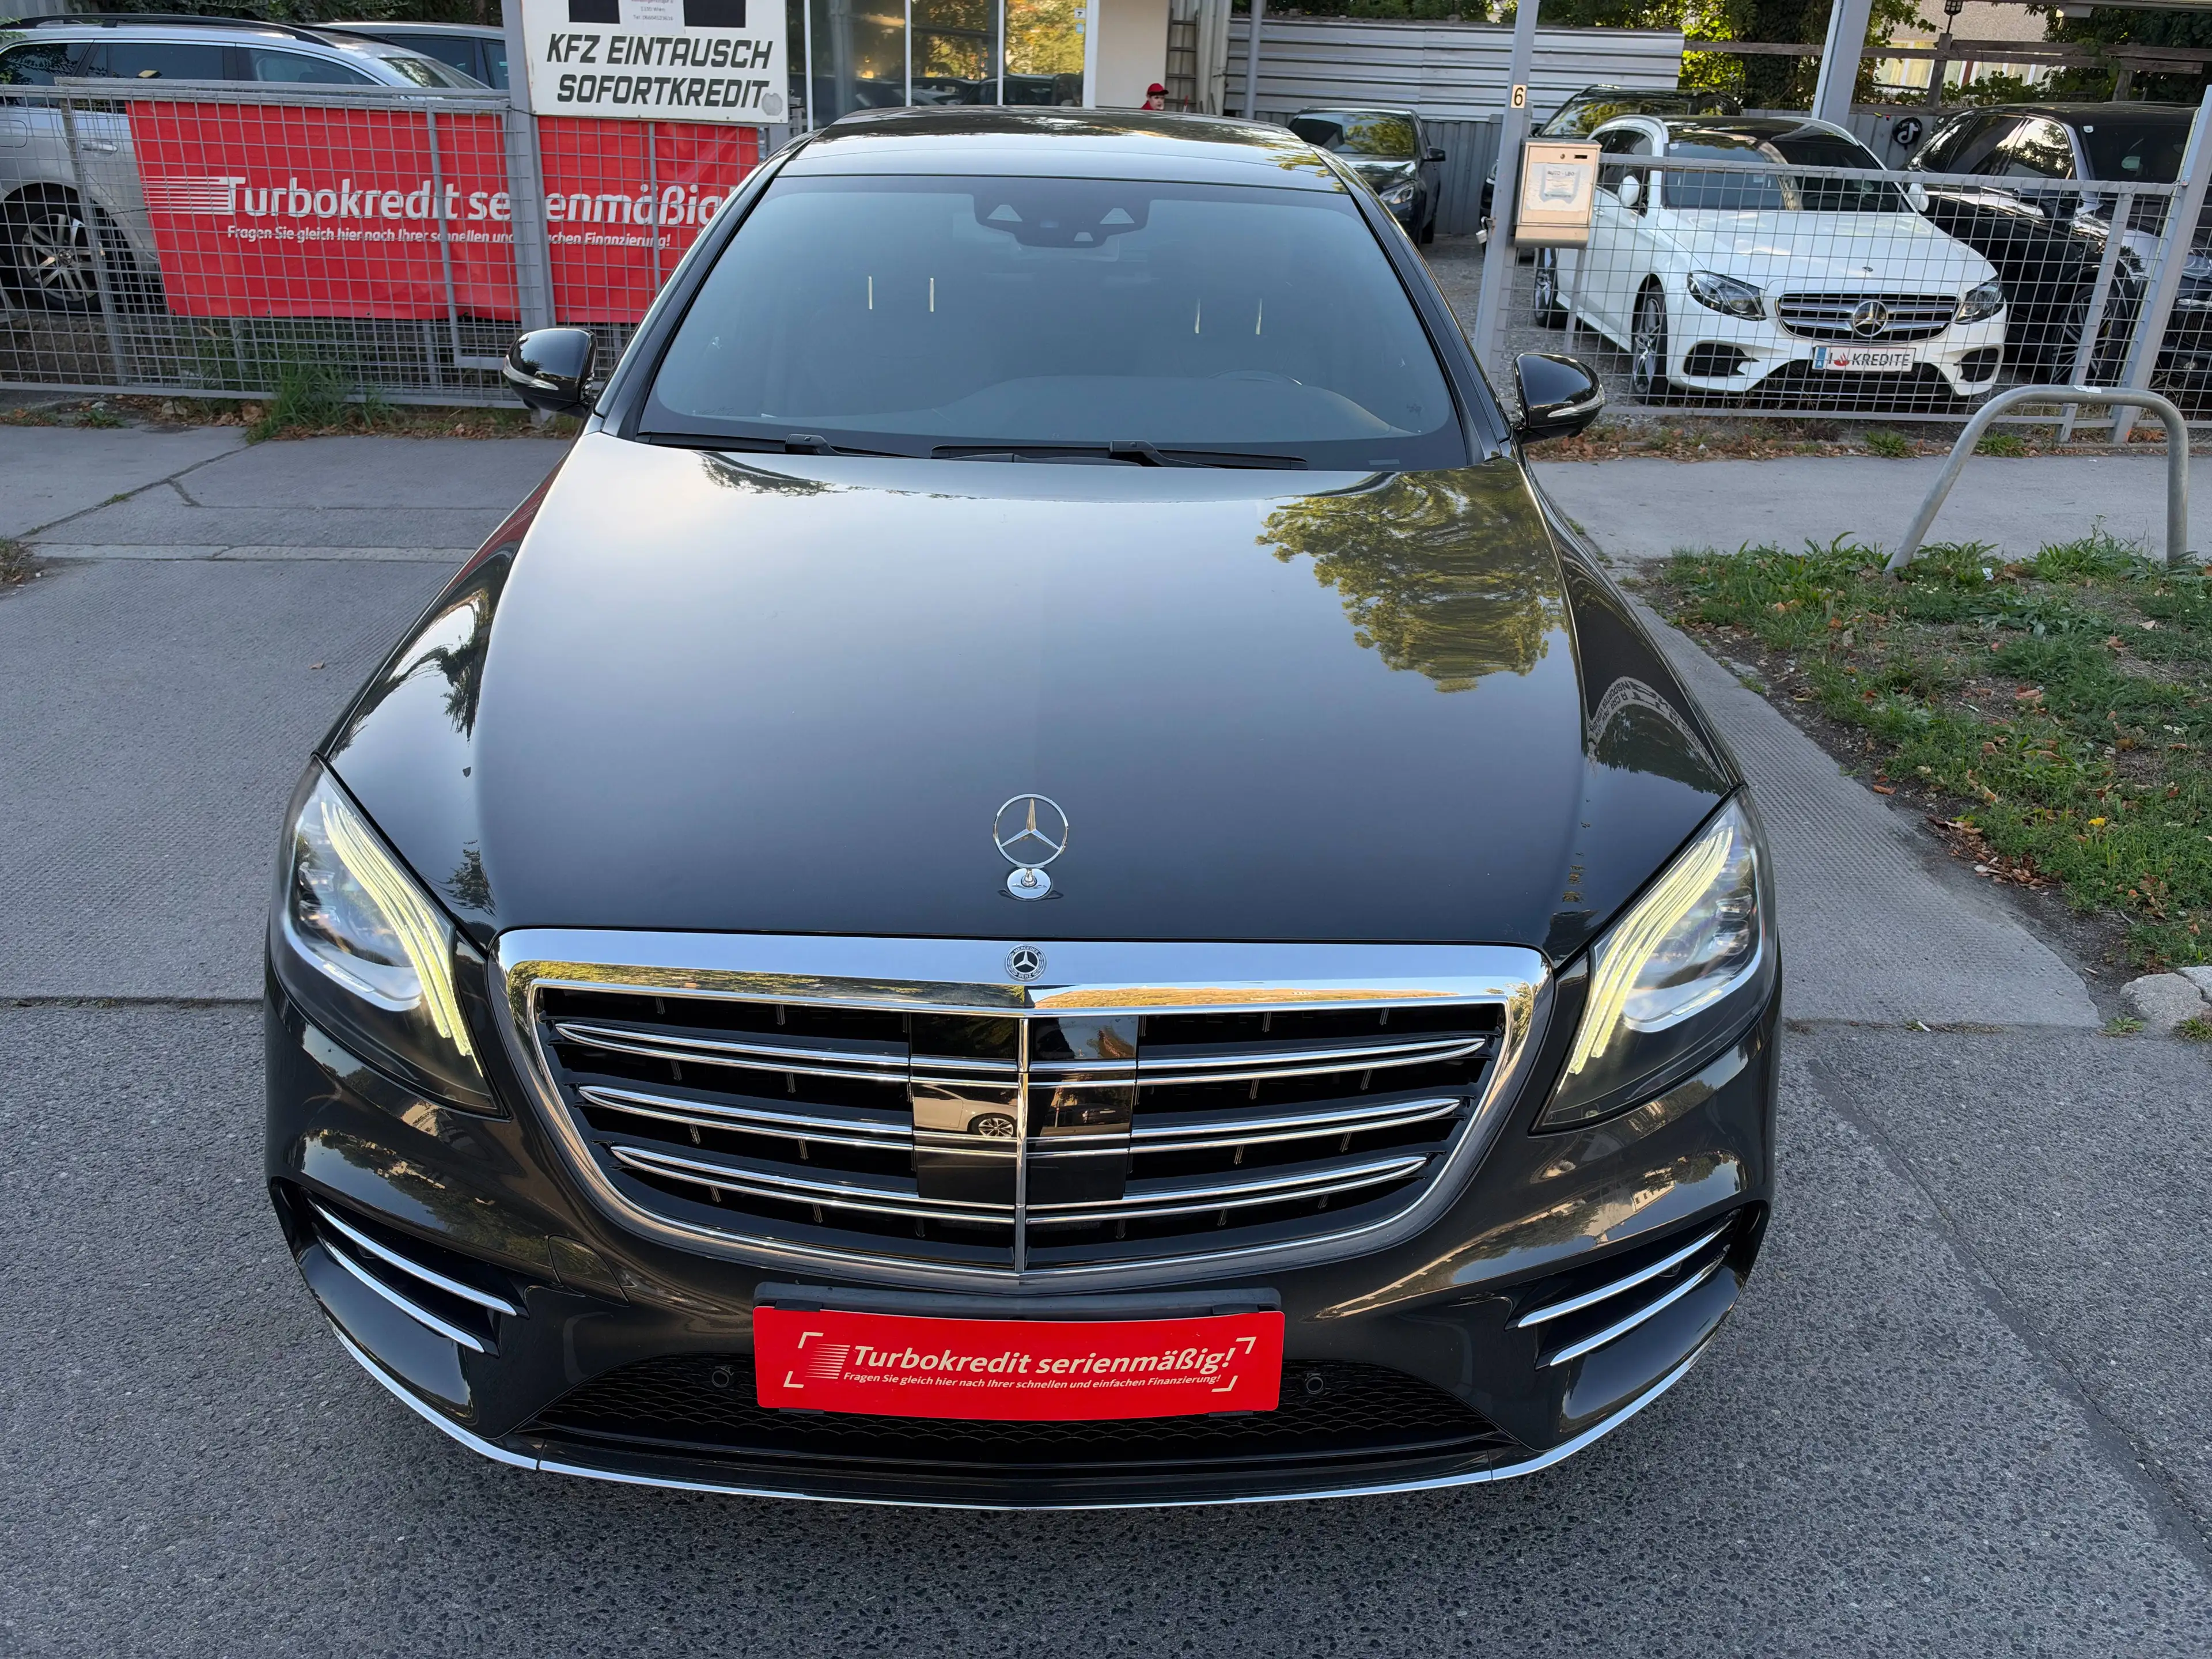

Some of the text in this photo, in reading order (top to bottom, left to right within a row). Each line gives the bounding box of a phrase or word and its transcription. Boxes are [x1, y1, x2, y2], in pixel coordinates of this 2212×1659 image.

[547, 33, 774, 69] KFZ EINTAUSCH
[557, 74, 770, 108] SOFORTKREDIT
[1514, 87, 1524, 106] 6
[228, 225, 272, 242] Fragen
[275, 226, 294, 240] Sie
[297, 227, 334, 243] gleich
[337, 228, 362, 241] hier
[364, 229, 395, 241] nach
[398, 229, 429, 242] Ihrer
[1852, 353, 1910, 366] KREDITE
[854, 1346, 1236, 1374] Turbokredit serienmäßig!
[843, 1372, 1221, 1389] Fragen Sie gleich hier nach Ihrer schnellen und einfachen Finanzierung!
